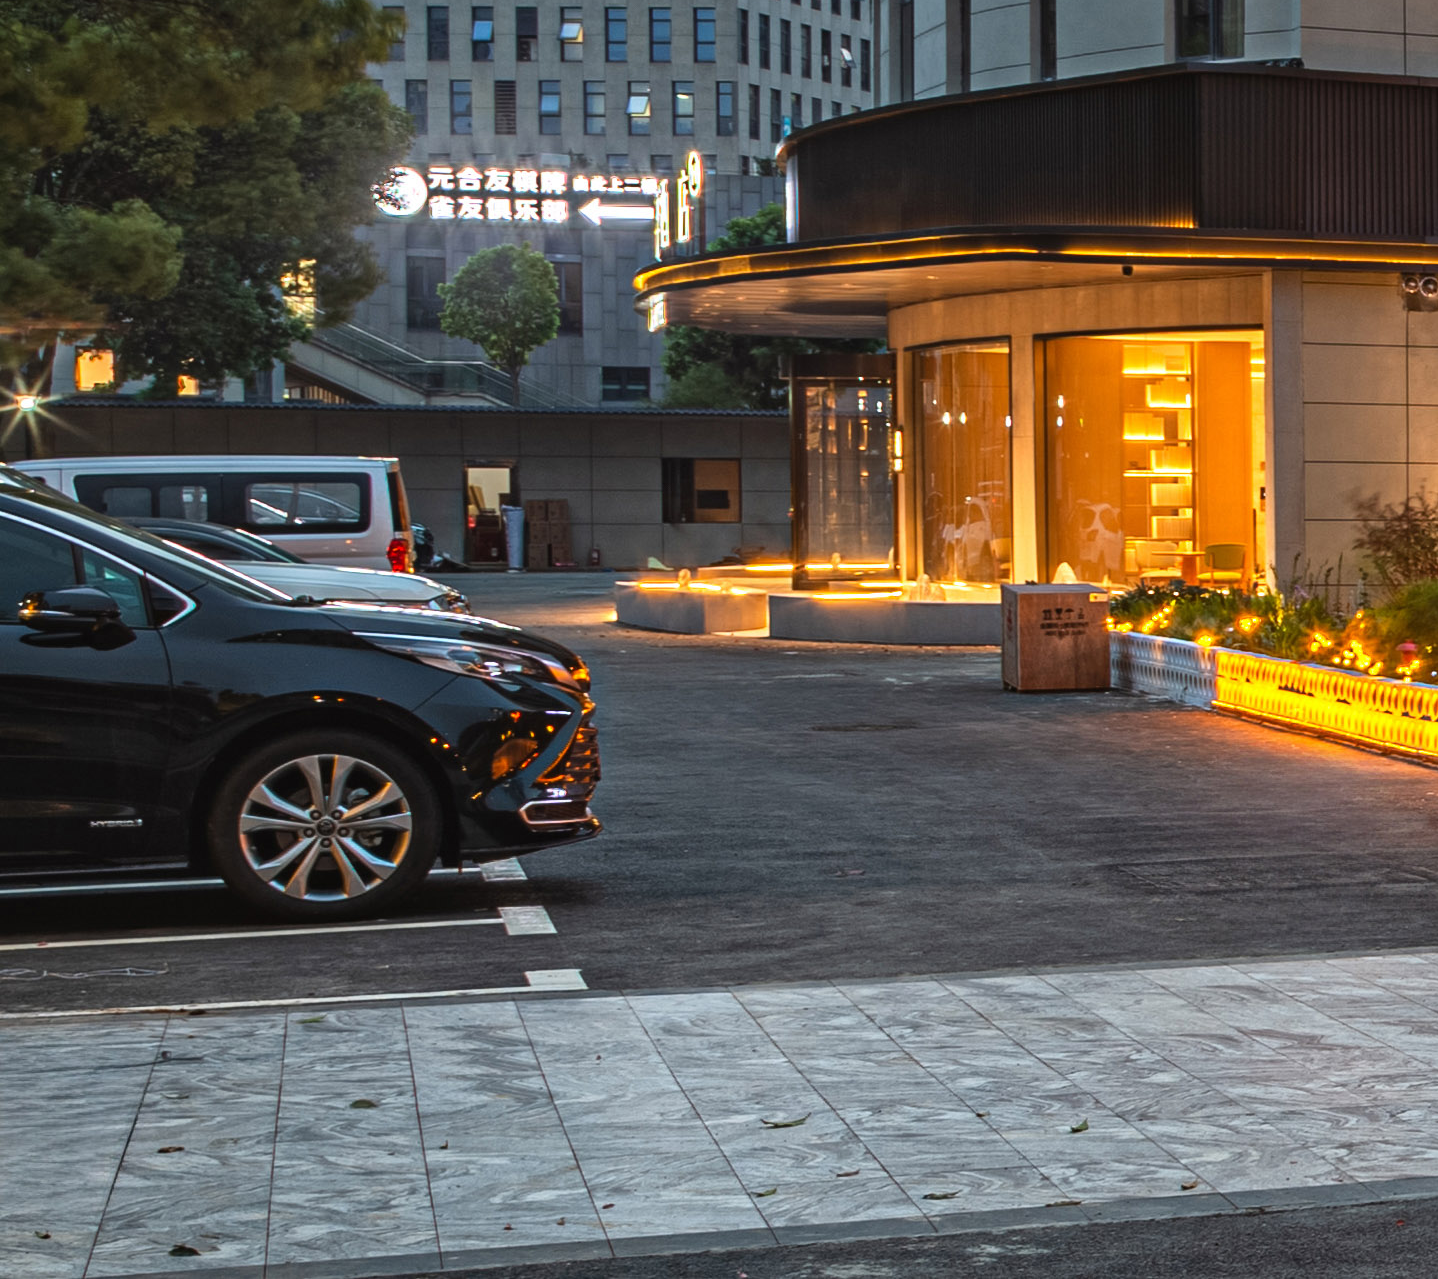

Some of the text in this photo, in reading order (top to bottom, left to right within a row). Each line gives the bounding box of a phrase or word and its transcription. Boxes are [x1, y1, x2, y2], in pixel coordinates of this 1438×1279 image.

[427, 165, 568, 194] 元合友棋牌
[428, 194, 569, 224] 雀友俱乐部
